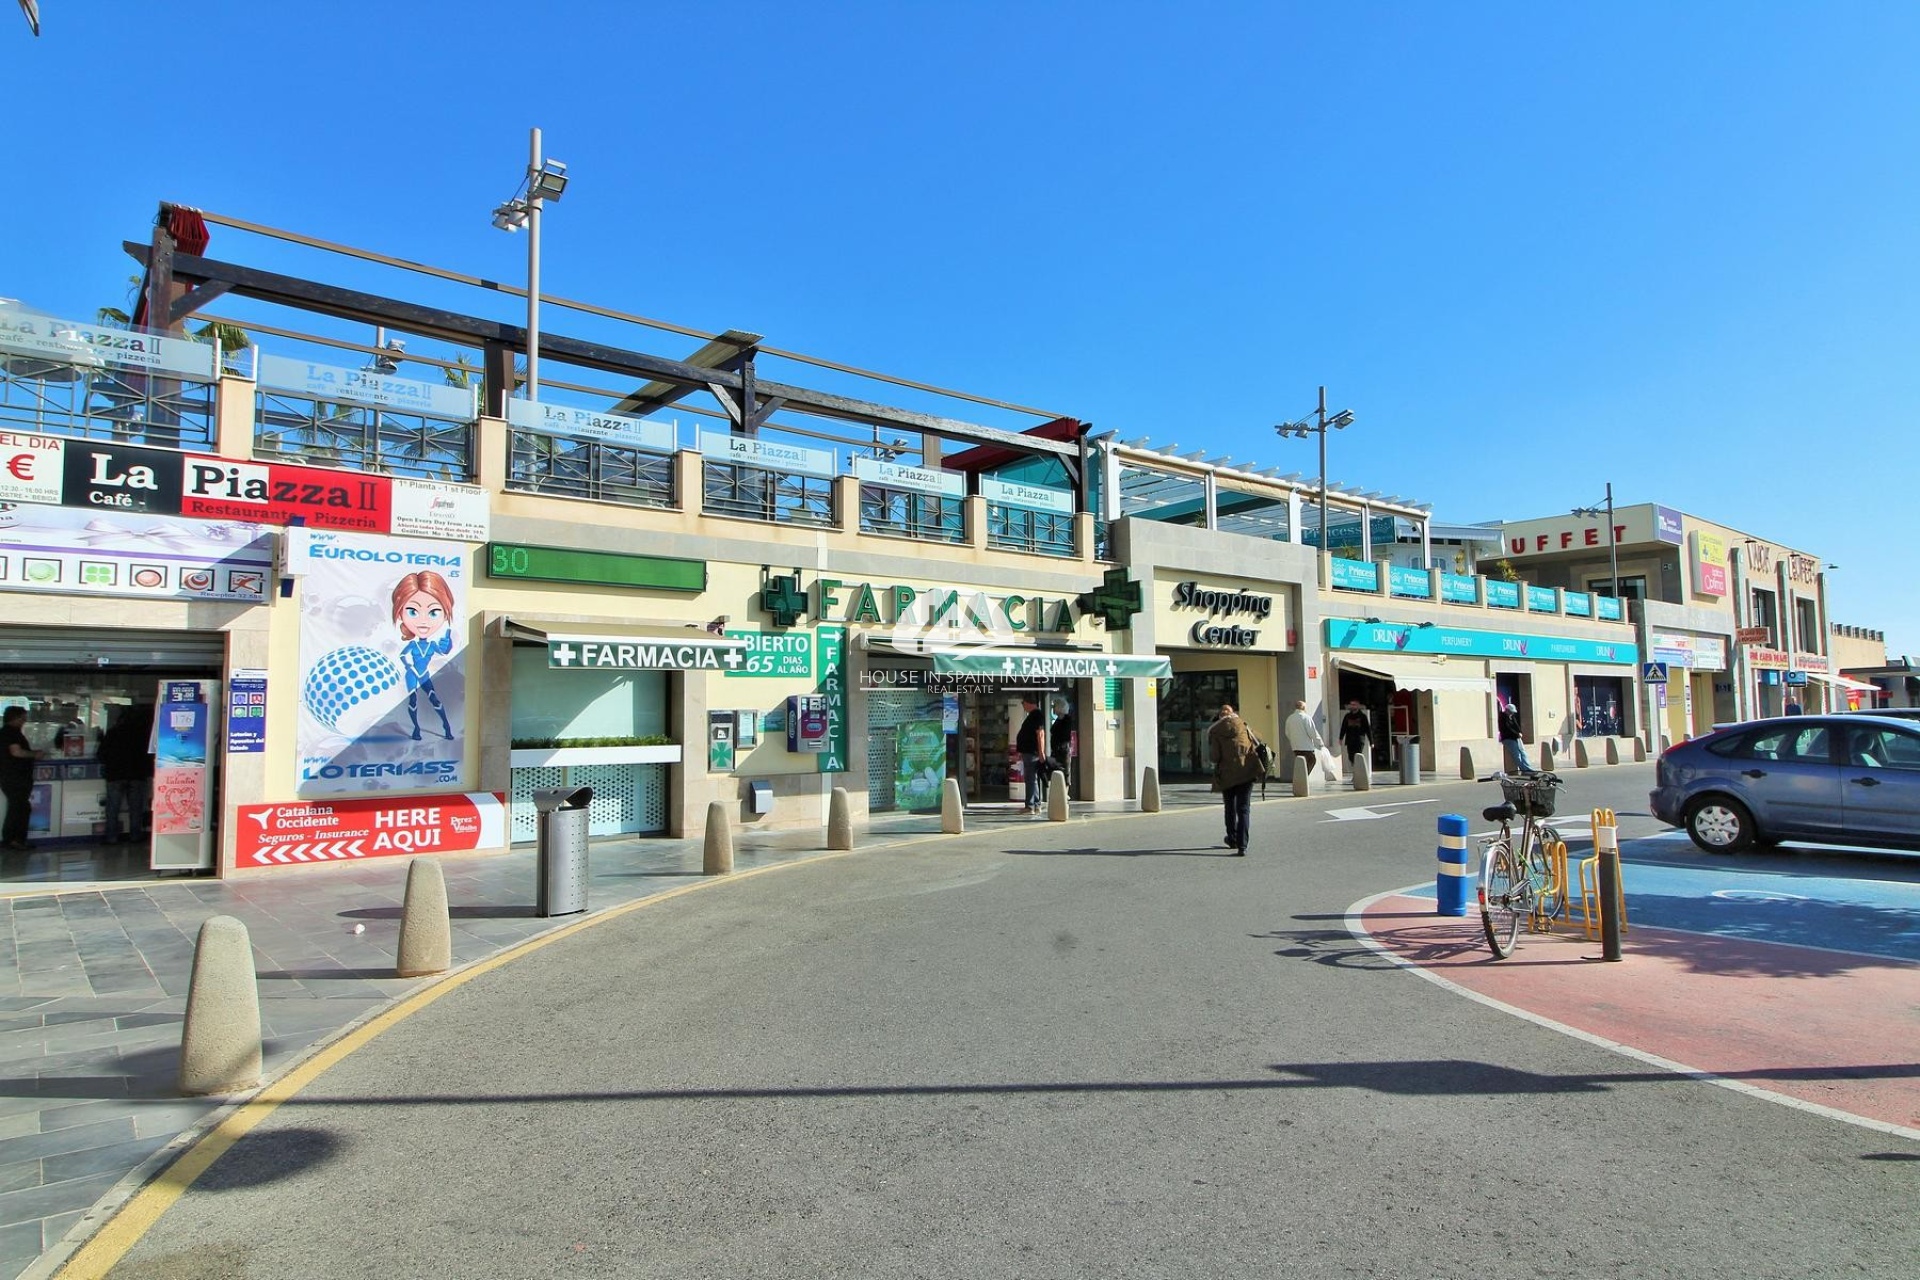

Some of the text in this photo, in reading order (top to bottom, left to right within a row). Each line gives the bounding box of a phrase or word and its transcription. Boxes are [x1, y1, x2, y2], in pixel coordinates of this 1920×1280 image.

[117, 352, 161, 364] pizzeria
[307, 365, 336, 383] La
[345, 371, 419, 398] Piazza
[335, 387, 389, 401] restaurante
[544, 405, 566, 421] La
[574, 412, 631, 431] Piazza
[566, 425, 608, 436] restaurante
[29, 438, 60, 450] DIA
[729, 439, 747, 452] La
[752, 442, 799, 460] Piazza
[90, 453, 158, 490] La
[878, 463, 893, 477] La
[897, 467, 936, 483] Piazza
[192, 464, 351, 511] Piazza
[410, 481, 436, 491] Planta
[460, 488, 481, 496] Floor
[1001, 484, 1014, 497] La
[1017, 486, 1049, 501] Piazza
[89, 490, 133, 507] Café
[315, 511, 377, 529] Pizzeria
[1303, 527, 1362, 539] Prcess
[1511, 526, 1627, 555] UFFET
[309, 543, 461, 567] EUROLOTERIA
[493, 545, 529, 574] 30
[1348, 566, 1376, 578] Princess
[1404, 573, 1429, 584] Princess
[1453, 581, 1476, 591] Princess
[819, 578, 1075, 634] FARMACIA
[1176, 581, 1273, 619] Shopping
[1192, 620, 1261, 646] Center
[581, 644, 719, 669] FARMACIA
[730, 655, 804, 674] 65 DIAS
[777, 664, 809, 675] AL AÑO
[1021, 658, 1101, 677] FARMACIA
[825, 646, 843, 770] FARMACIA
[303, 759, 460, 780] LOTERIASS
[276, 804, 334, 818] Catalana
[375, 807, 442, 829] HERE
[276, 815, 340, 829] Occidente
[258, 832, 305, 846] Seguros
[314, 828, 370, 840] Insurance
[372, 828, 442, 851] AQUI
